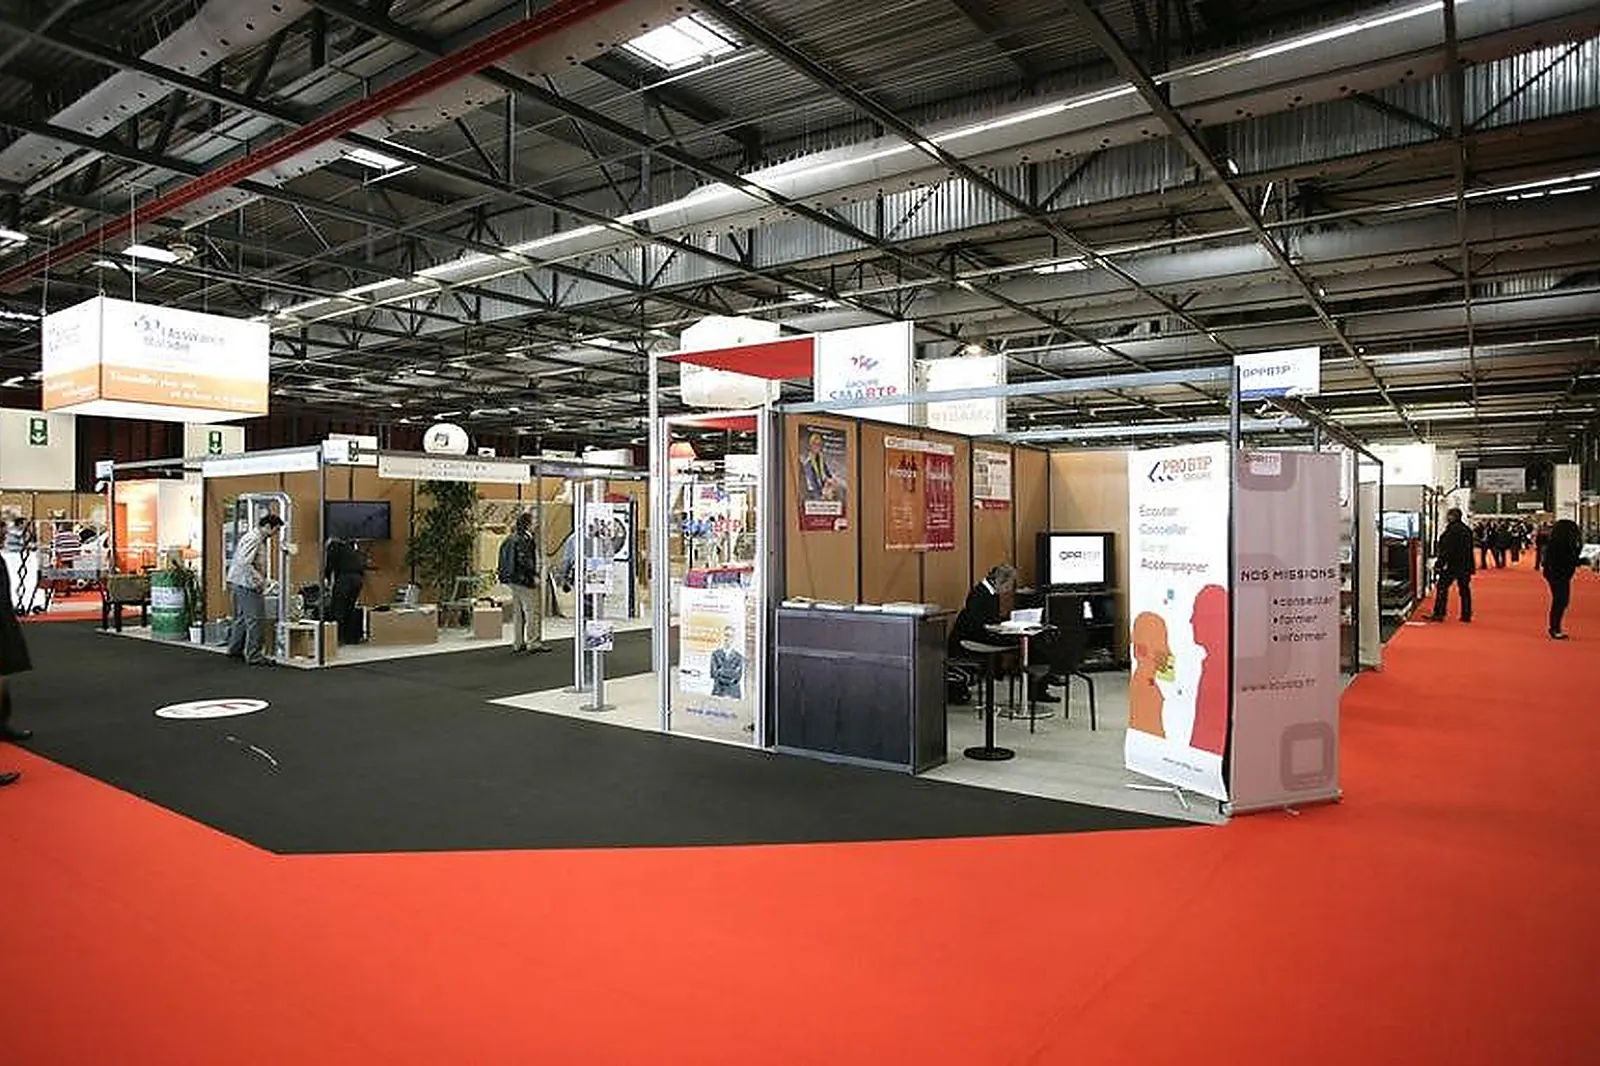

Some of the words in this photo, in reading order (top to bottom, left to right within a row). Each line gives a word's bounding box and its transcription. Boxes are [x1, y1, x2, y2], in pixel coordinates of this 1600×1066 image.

[1240, 569, 1269, 581] NOS
[1273, 567, 1336, 580] MISSIONS
[1279, 614, 1318, 625] former
[1279, 631, 1327, 642] informer
